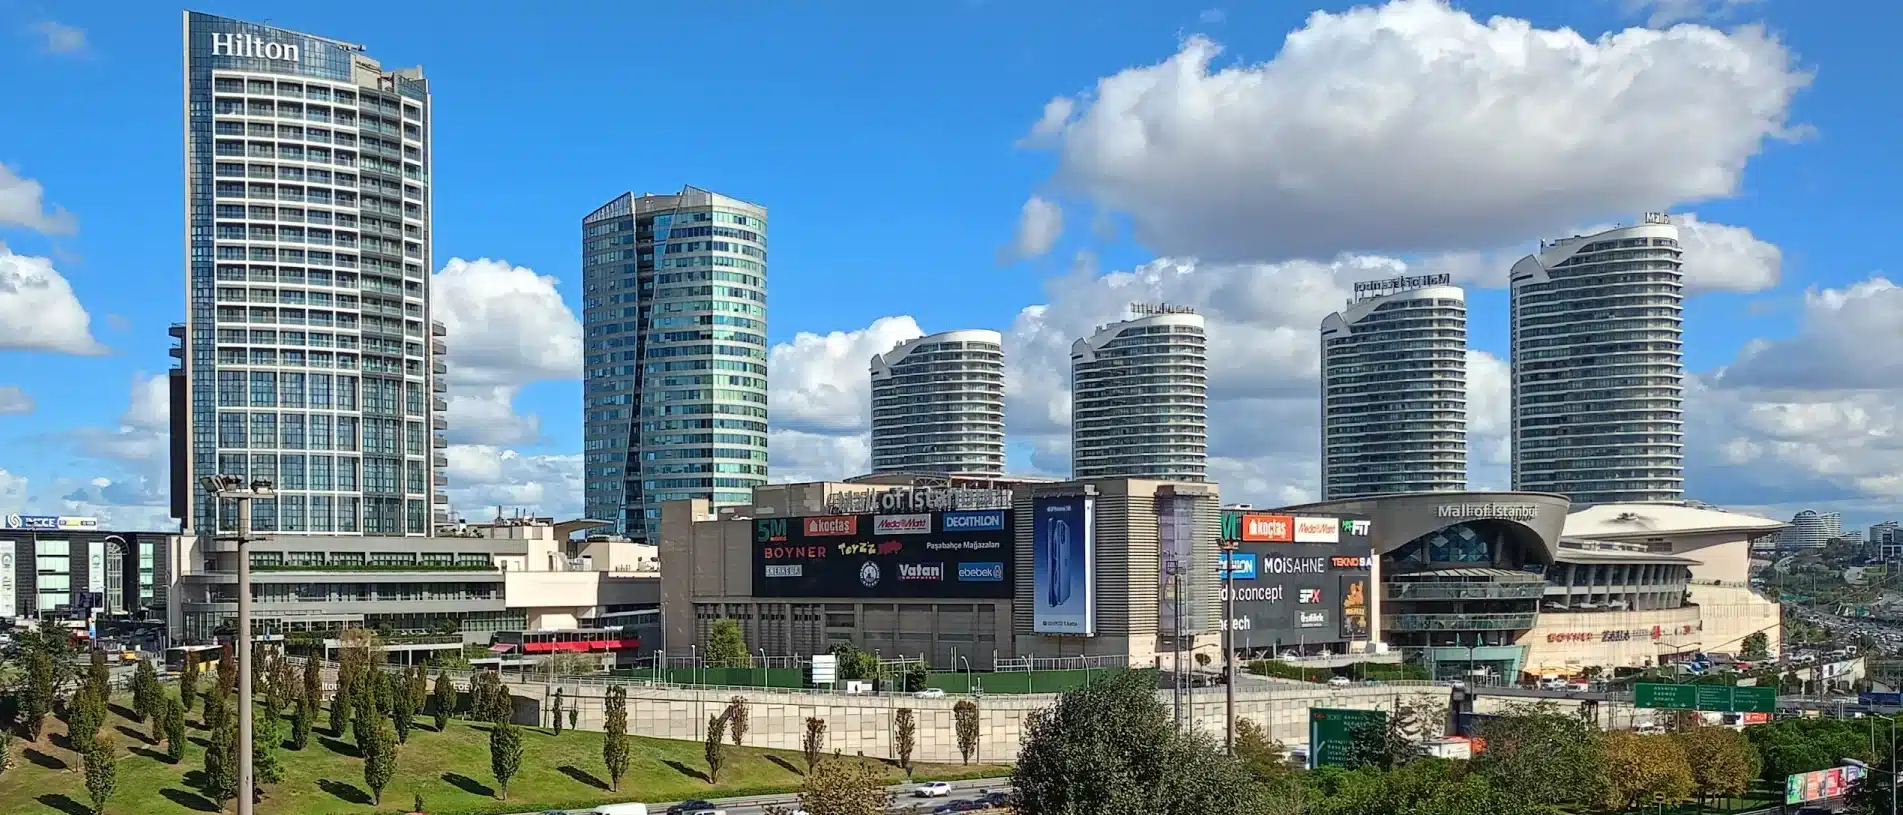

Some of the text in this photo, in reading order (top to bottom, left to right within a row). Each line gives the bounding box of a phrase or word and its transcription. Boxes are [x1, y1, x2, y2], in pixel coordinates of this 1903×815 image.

[212, 33, 299, 61] Hilton
[882, 487, 904, 509] of
[1438, 503, 1470, 517] Mall
[1474, 503, 1489, 517] of
[818, 518, 850, 533] koçtaş
[946, 515, 999, 527] DECATHLON
[757, 519, 787, 541] 5M
[1257, 518, 1286, 539] koçtaş
[764, 546, 827, 559] BOYNER
[926, 540, 1000, 551] Paşabahçe Mağazaları
[1331, 557, 1372, 567] TEKNOSA
[899, 564, 939, 576] Vatan
[959, 568, 992, 577] ebebek
[1299, 589, 1320, 603] SPX
